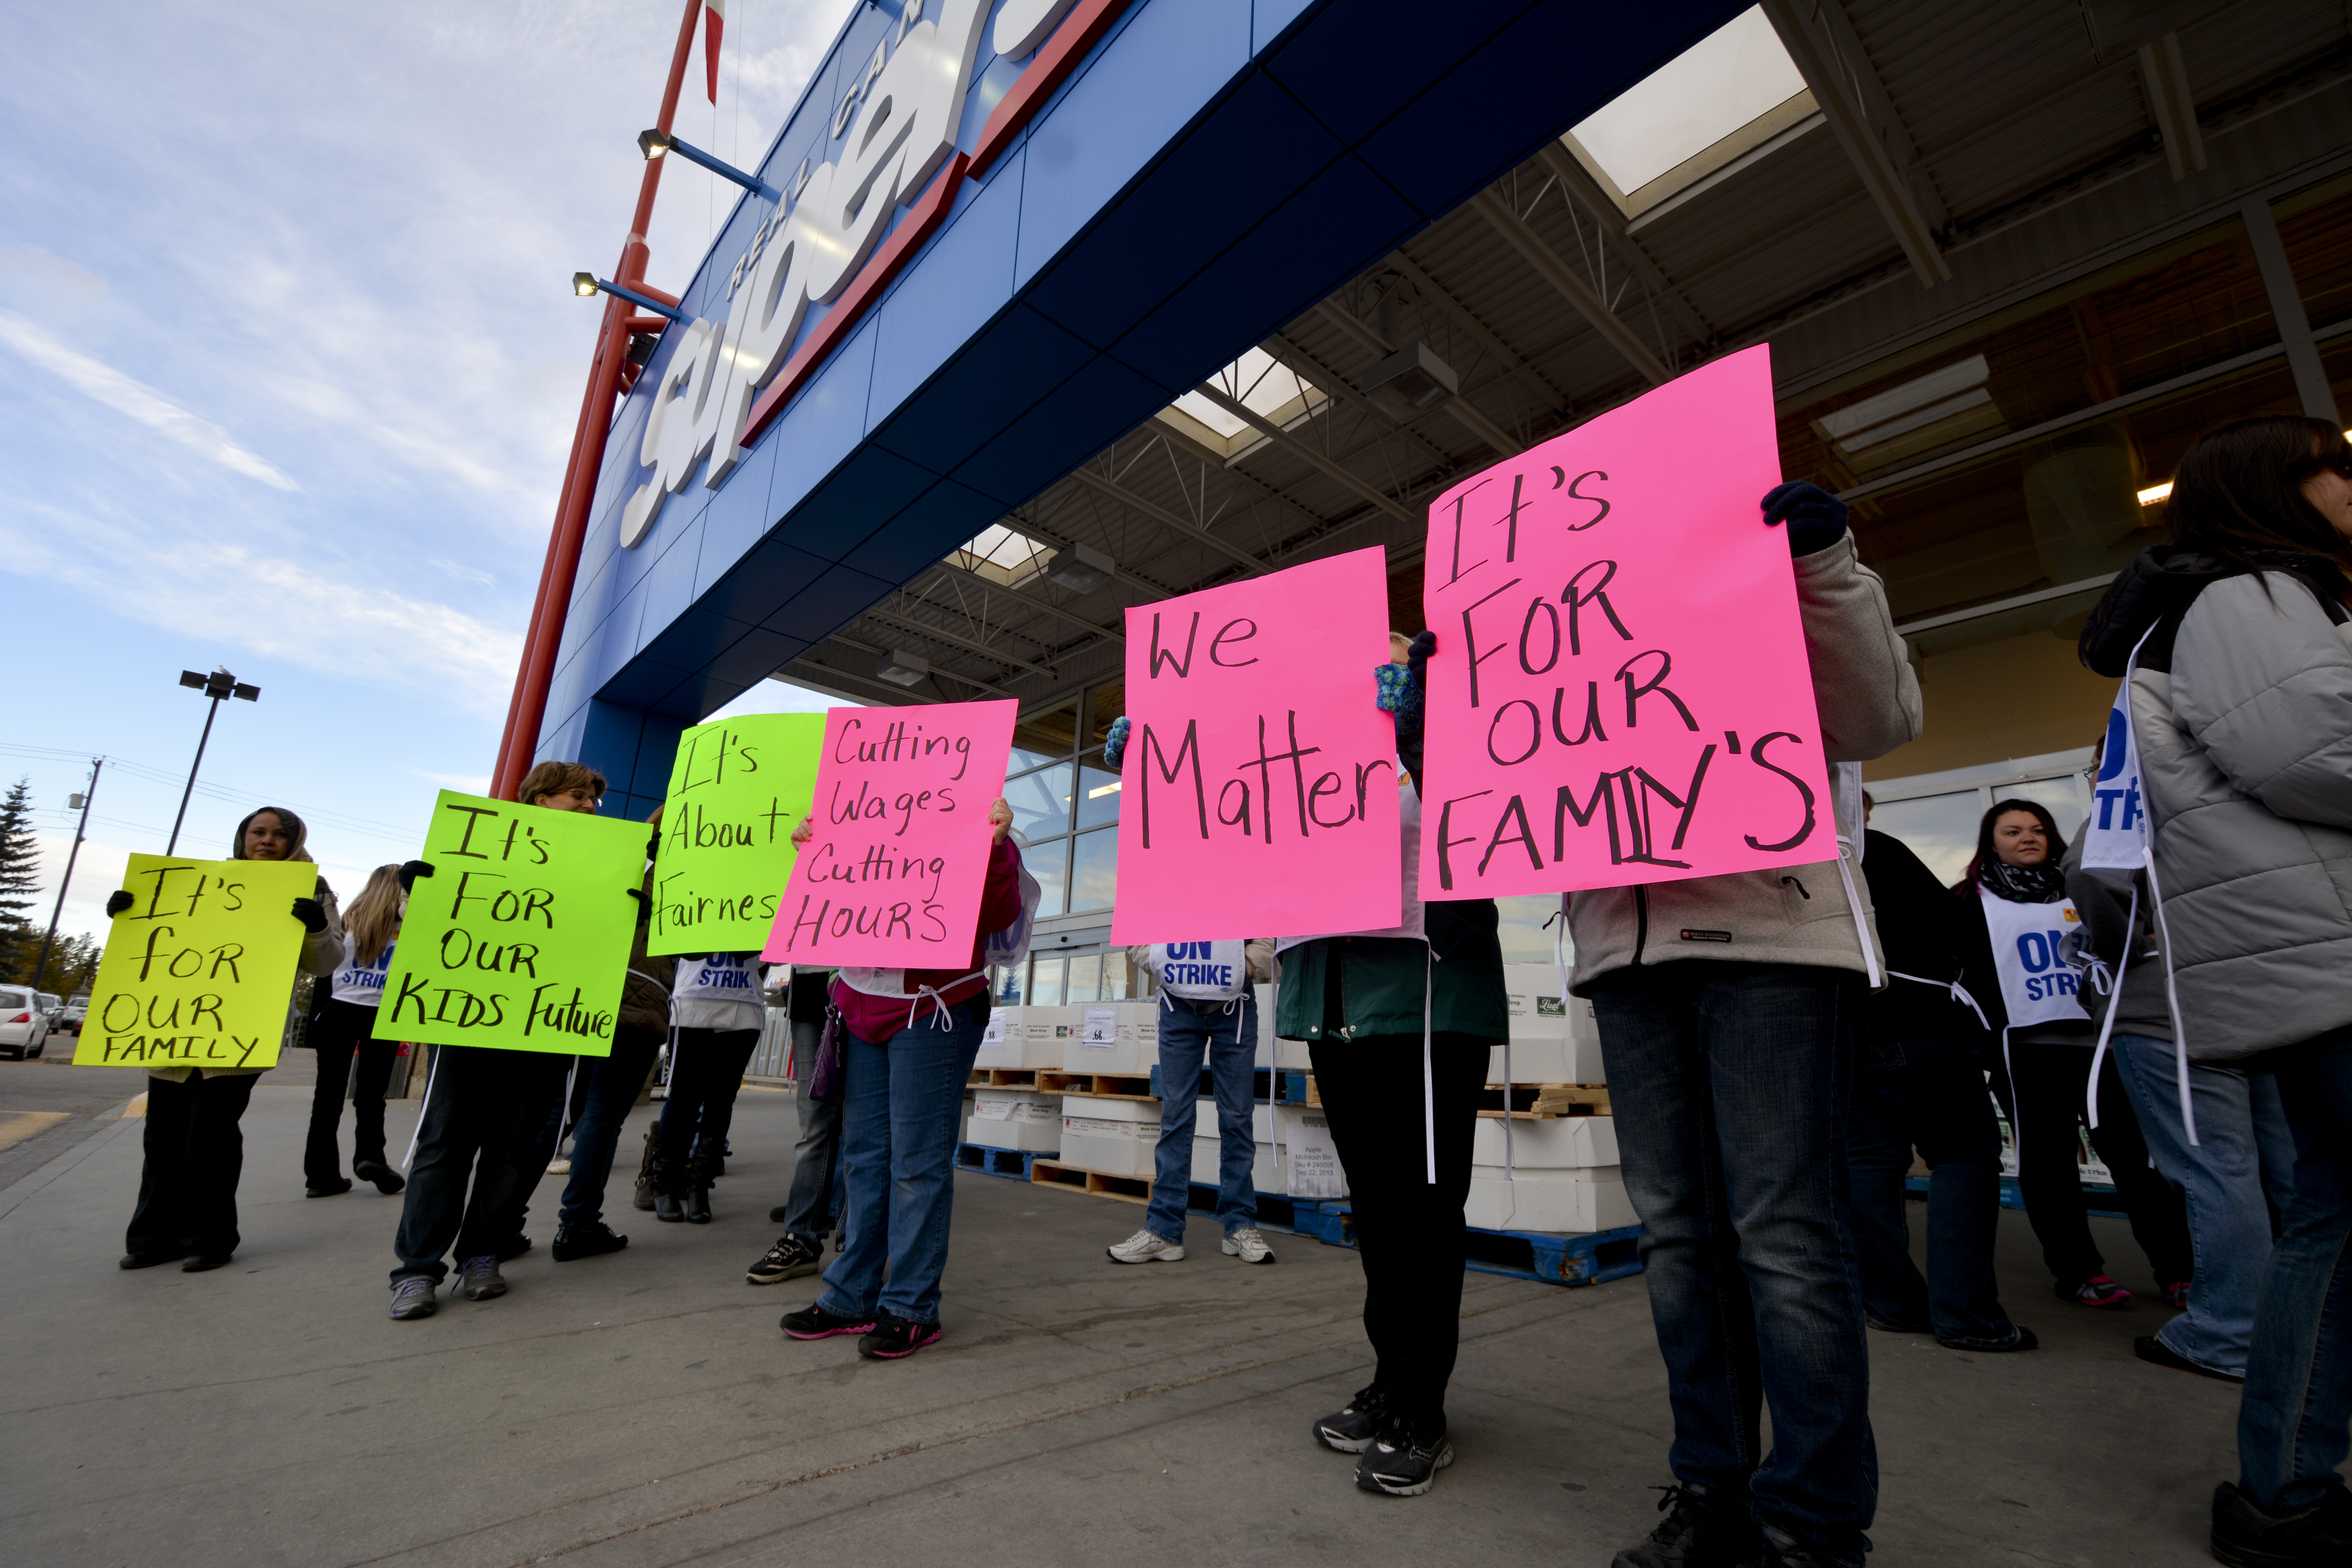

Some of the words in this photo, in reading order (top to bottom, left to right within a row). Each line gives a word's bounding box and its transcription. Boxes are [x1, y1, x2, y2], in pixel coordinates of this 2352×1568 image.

[726, 157, 810, 302] REAL
[832, 0, 923, 140] CAN
[1436, 465, 1611, 593] It's
[1150, 612, 1259, 679] We
[1462, 559, 1633, 708] FOR
[1488, 649, 1699, 766] OUR
[673, 726, 758, 797] It's
[836, 719, 971, 780] Cutting
[1142, 710, 1392, 849] Matter
[440, 804, 550, 864] It's
[666, 797, 790, 855] About
[831, 781, 955, 836] Wages
[129, 866, 245, 920] It's
[450, 871, 554, 929] FOR
[654, 872, 777, 936] Fairnes
[808, 843, 945, 904] Cutting
[343, 969, 387, 989] STRIK
[699, 969, 751, 988] STRIK
[1164, 963, 1231, 986] STRIKE
[391, 972, 509, 1028] KIDS
[524, 983, 612, 1039] Future
[103, 1033, 259, 1067] FAMILY
